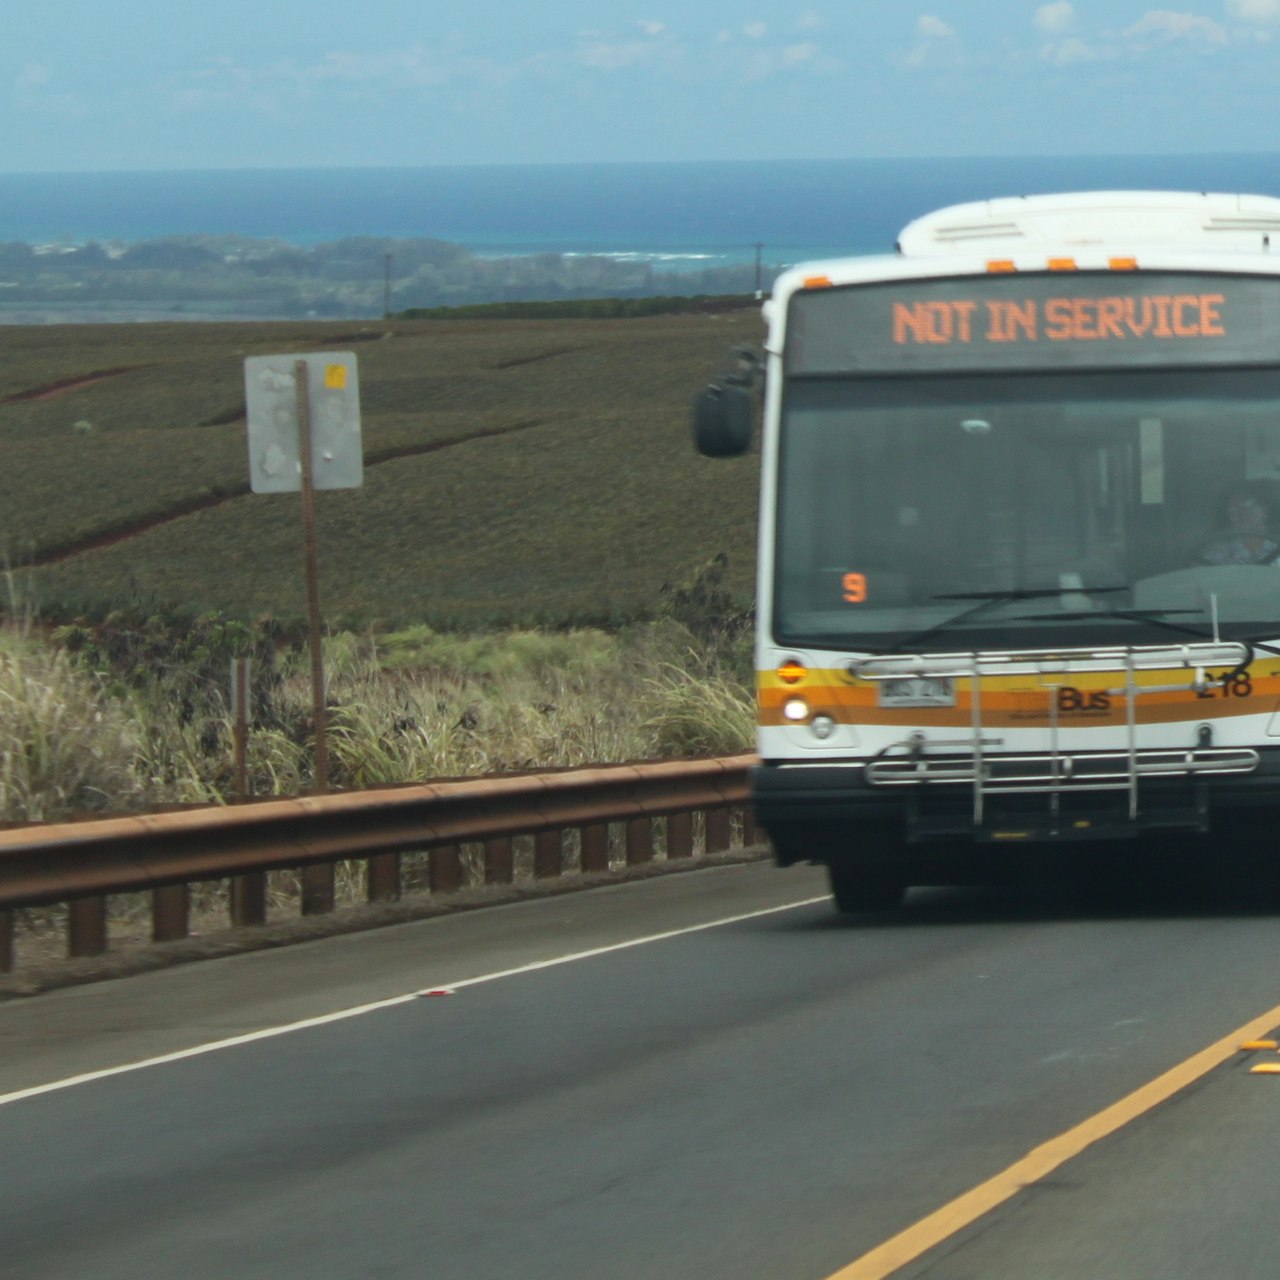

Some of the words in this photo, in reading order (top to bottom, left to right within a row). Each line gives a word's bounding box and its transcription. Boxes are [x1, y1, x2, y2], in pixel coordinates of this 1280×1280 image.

[892, 299, 976, 344] NOT
[985, 298, 1037, 342] IN
[1044, 293, 1226, 340] SERVICE
